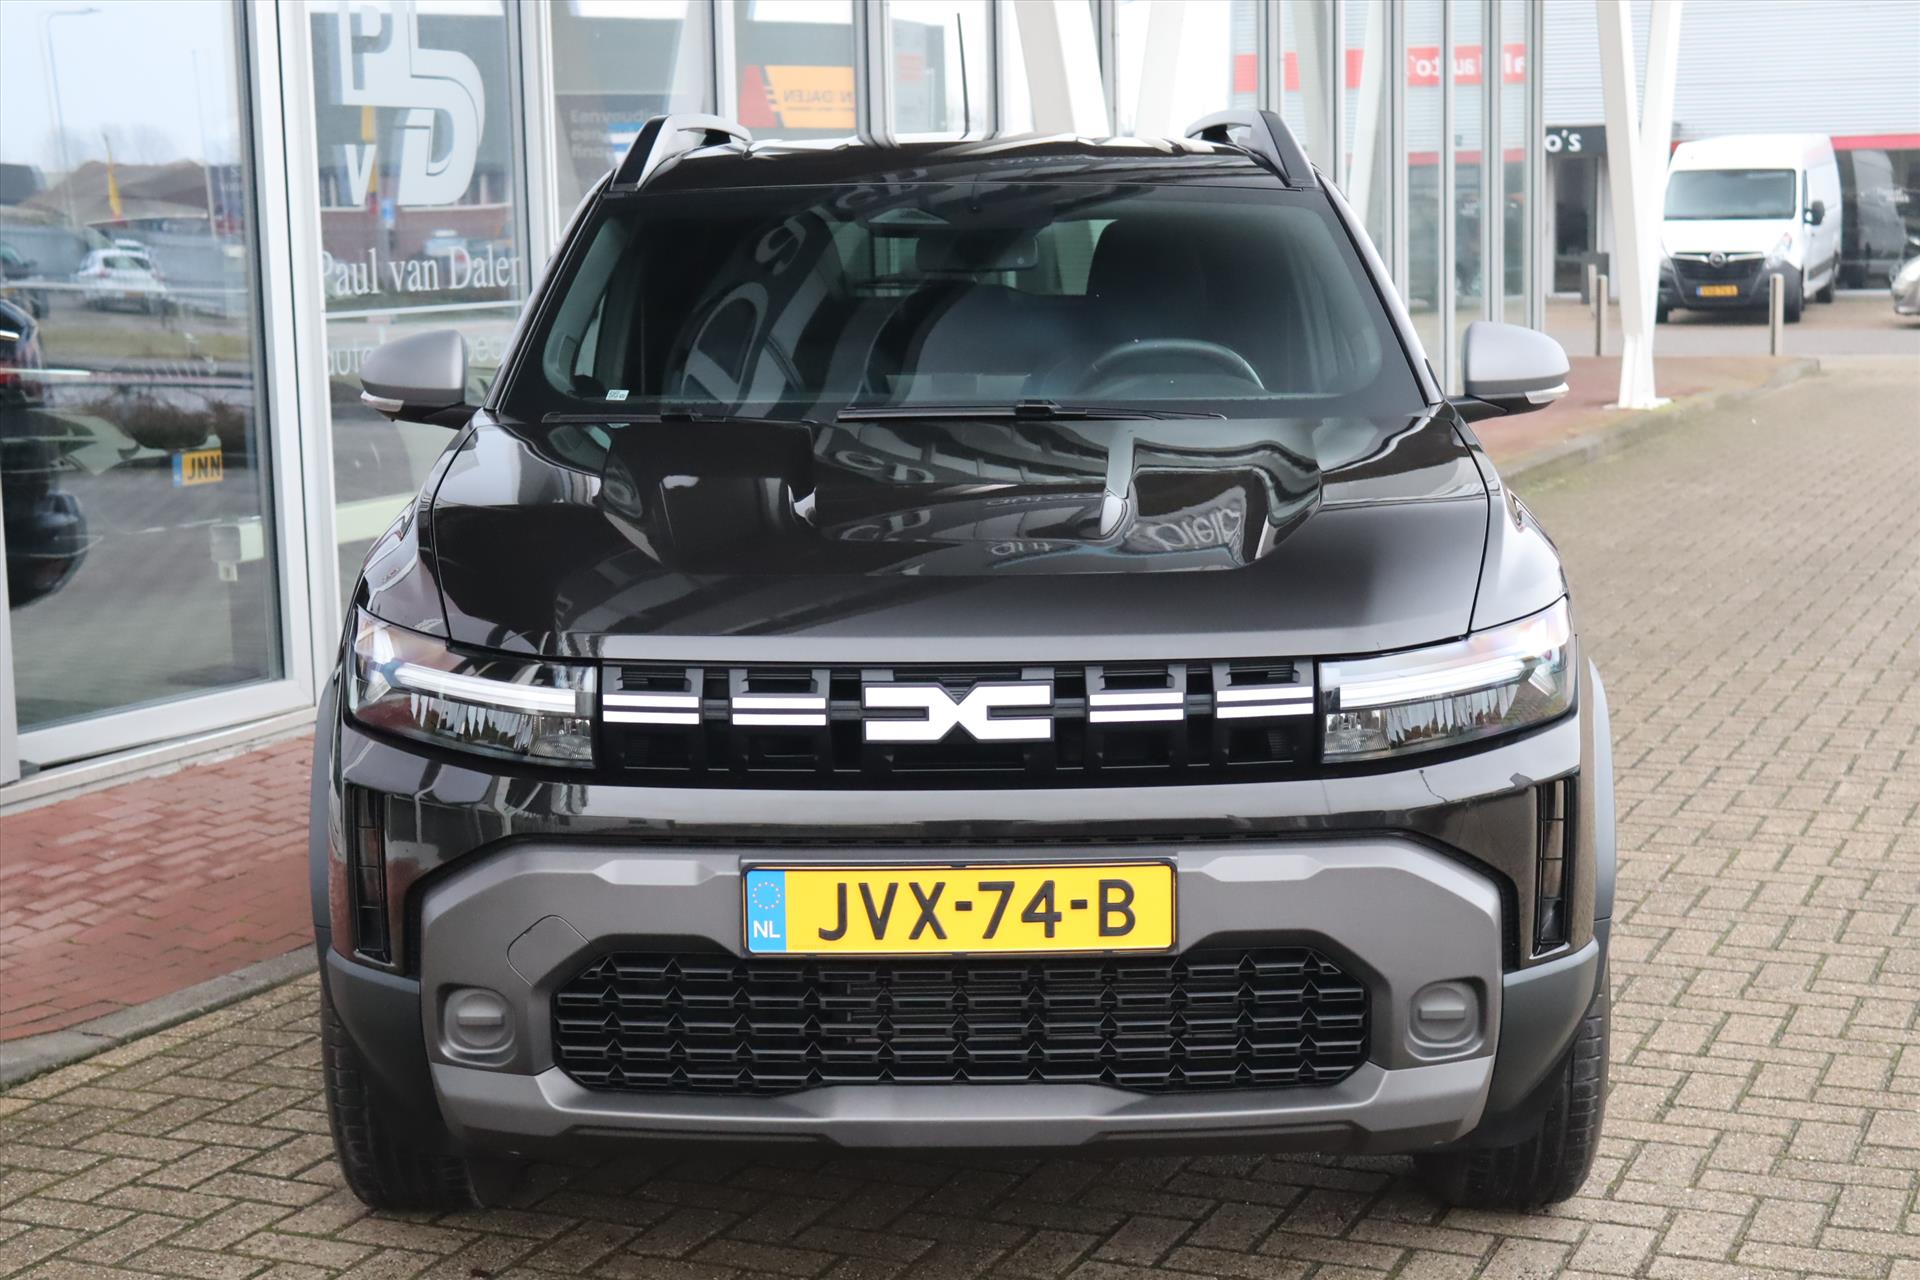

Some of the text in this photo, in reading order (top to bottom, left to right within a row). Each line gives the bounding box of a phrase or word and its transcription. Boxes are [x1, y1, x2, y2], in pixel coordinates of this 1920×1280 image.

[389, 259, 439, 292] van
[753, 879, 1137, 941] NL JVX-74-B
